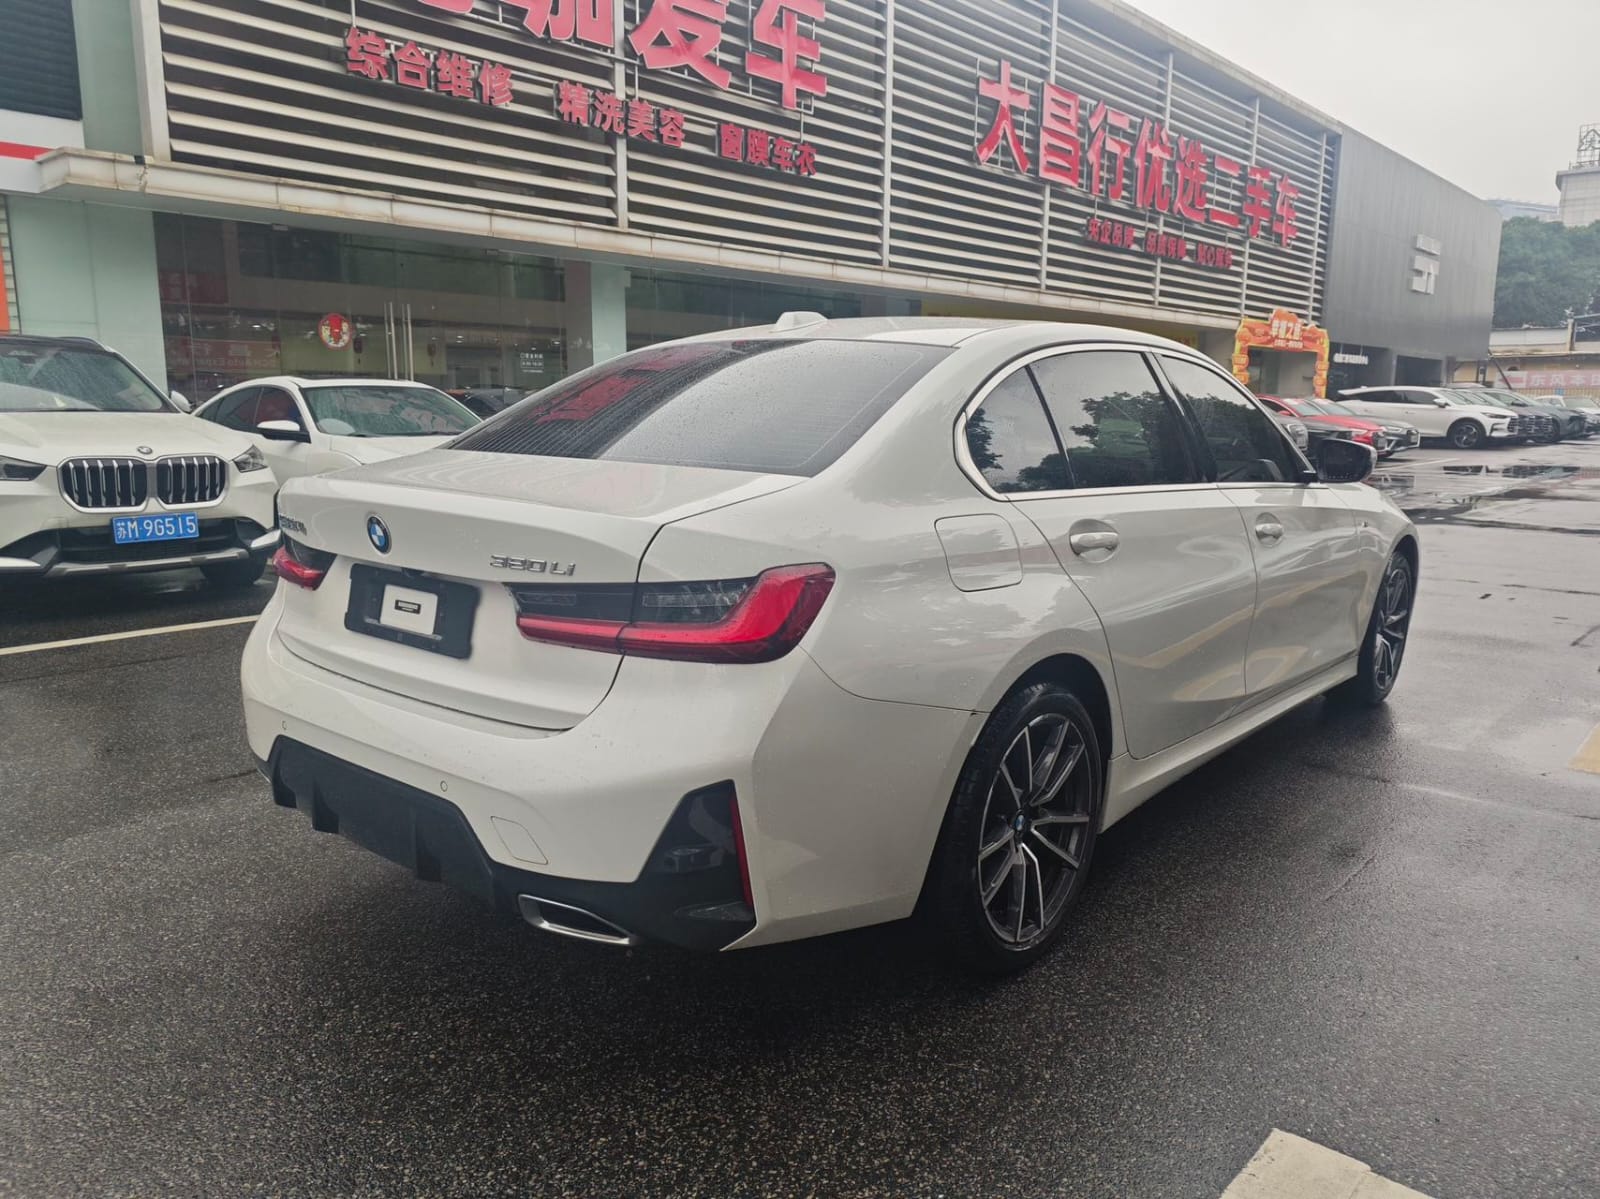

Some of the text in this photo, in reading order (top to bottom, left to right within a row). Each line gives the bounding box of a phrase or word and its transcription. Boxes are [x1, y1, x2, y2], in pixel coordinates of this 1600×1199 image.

[345, 27, 513, 106] 综合维修
[558, 80, 685, 148] 精洗美容
[976, 59, 1299, 248] 大昌行优选二手车
